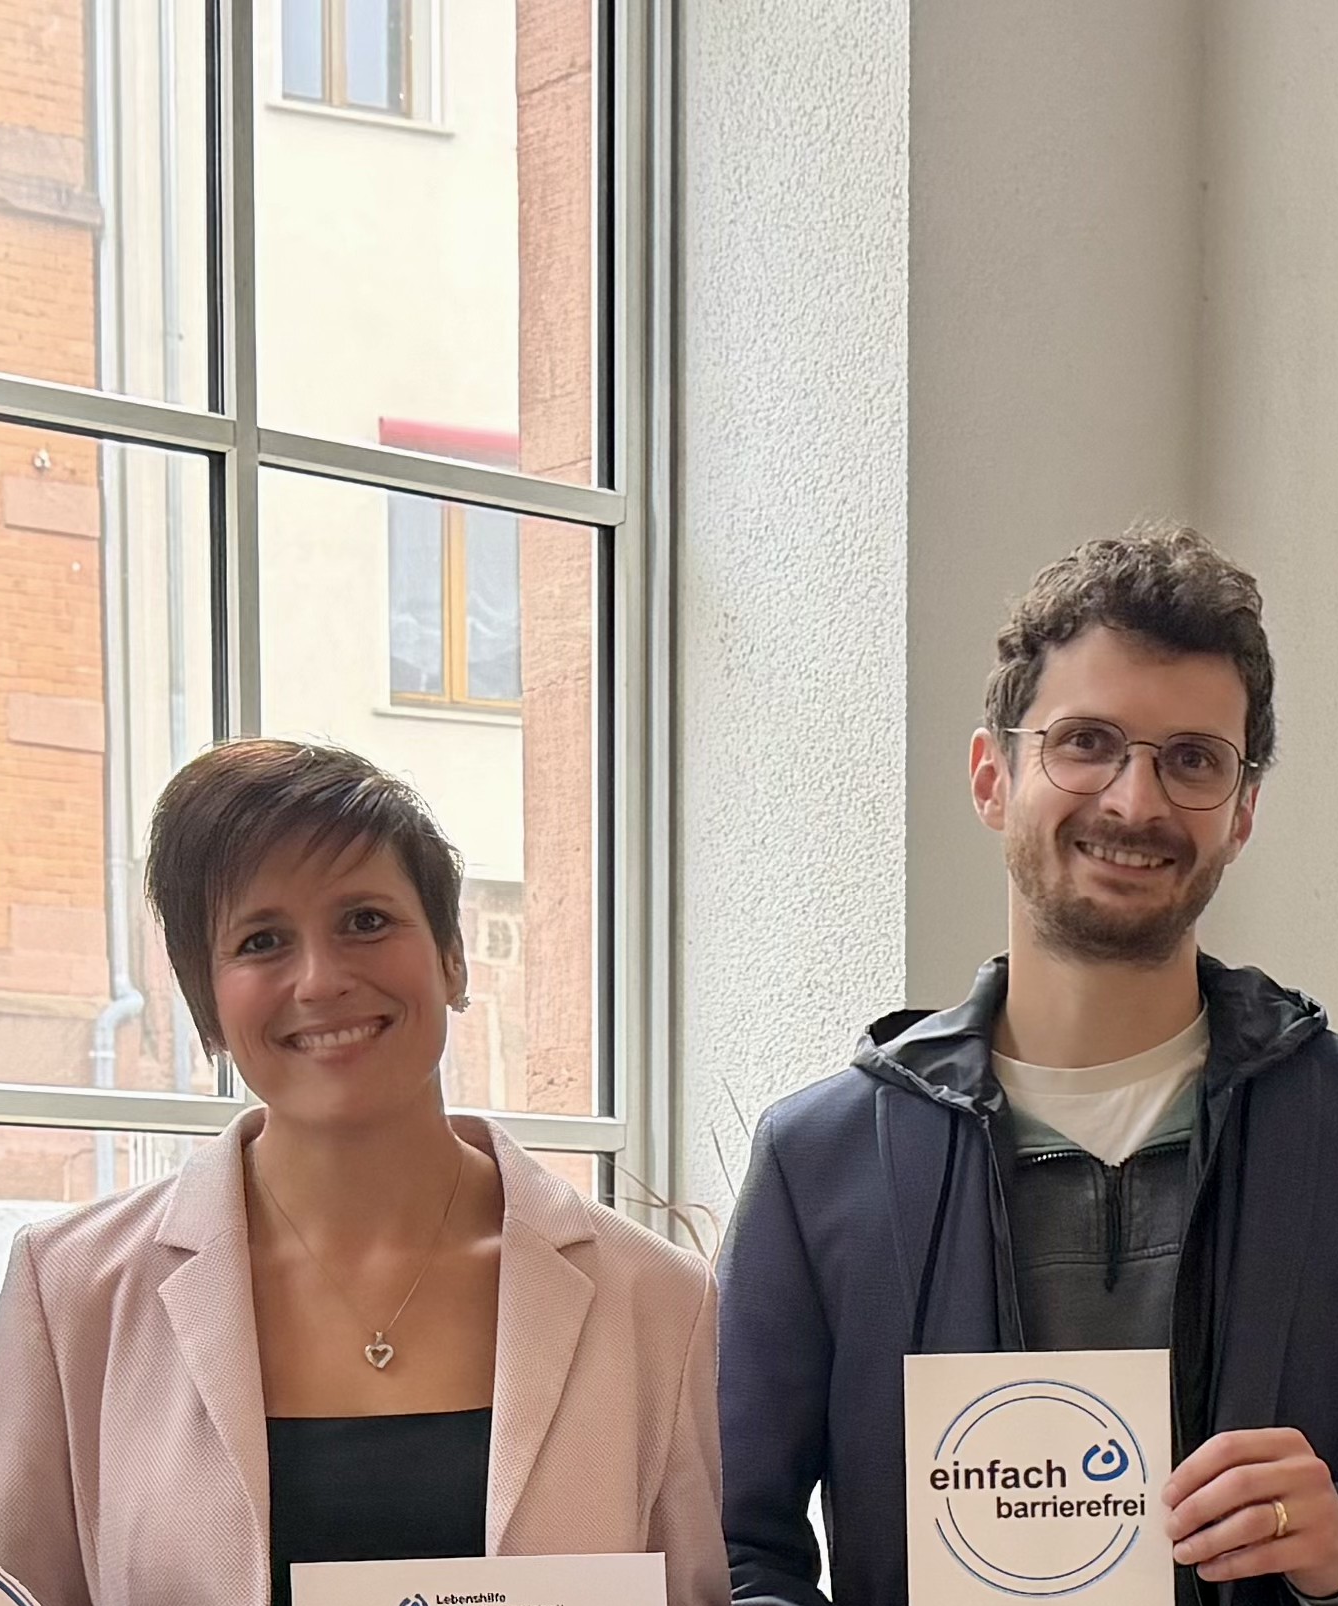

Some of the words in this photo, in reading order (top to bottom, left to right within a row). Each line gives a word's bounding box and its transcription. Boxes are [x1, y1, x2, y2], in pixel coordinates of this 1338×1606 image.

[930, 1460, 1067, 1491] einfach
[996, 1493, 1146, 1518] barrierefrei
[436, 1593, 506, 1605] Lebenshilfe
